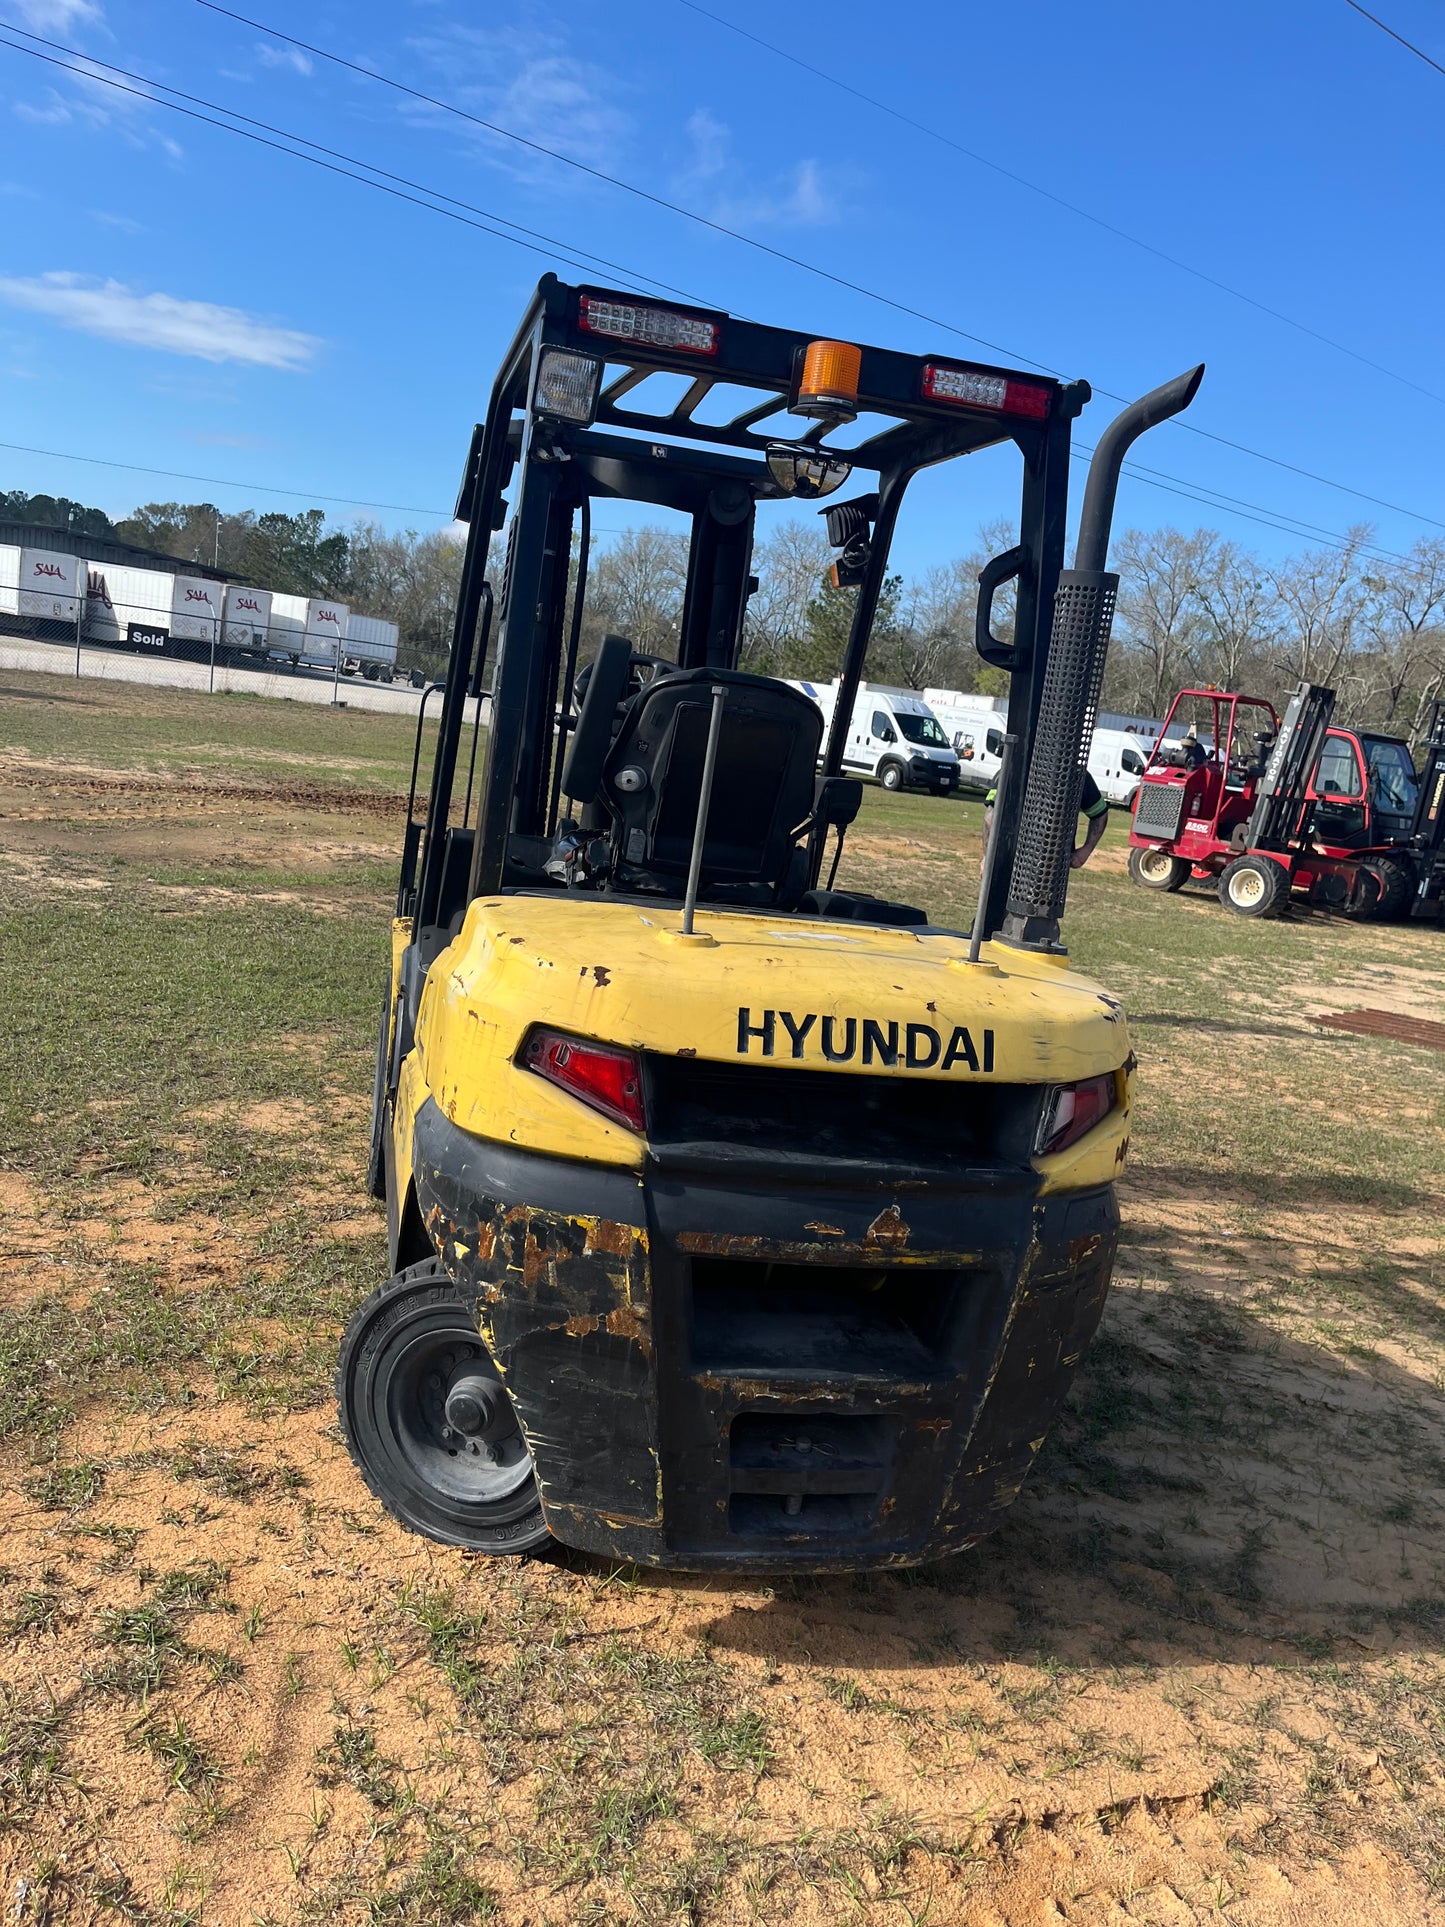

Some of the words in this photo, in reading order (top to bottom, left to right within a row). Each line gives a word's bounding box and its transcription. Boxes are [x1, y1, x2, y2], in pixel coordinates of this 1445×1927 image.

[34, 563, 67, 581] SAIA
[185, 589, 212, 605] SAIA
[236, 598, 262, 613] SAIA
[317, 610, 340, 625] SAIA
[132, 631, 164, 647] Sold
[1267, 725, 1291, 782] NAVIGATOR
[737, 1007, 995, 1073] HYUNDAI
